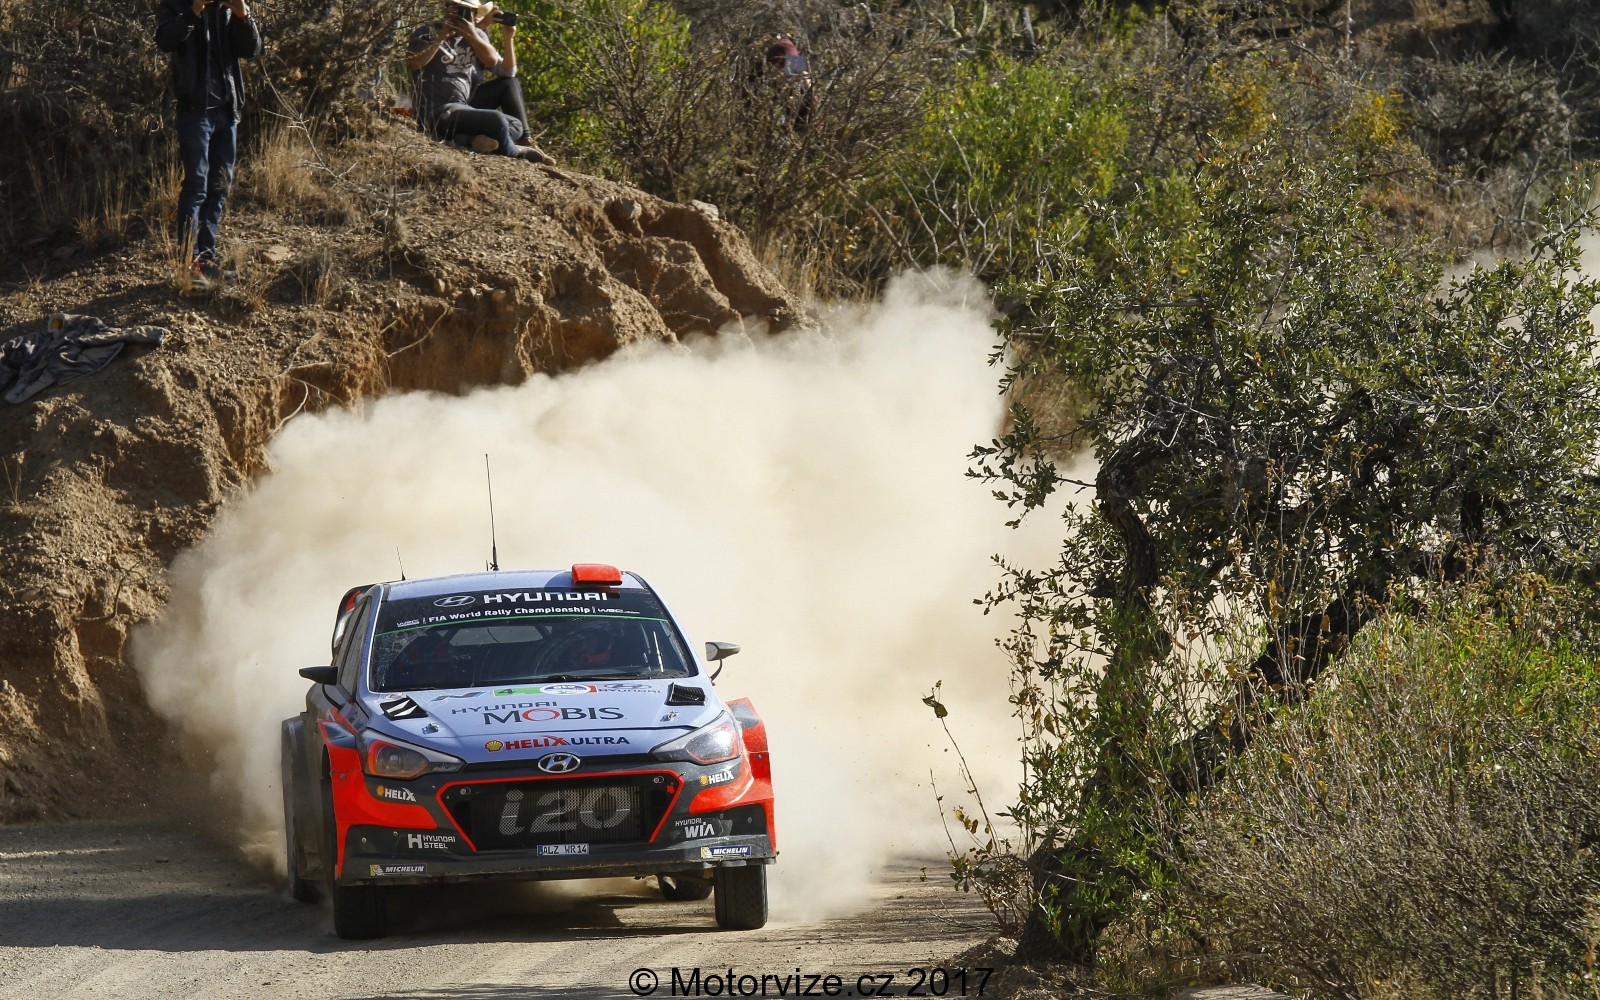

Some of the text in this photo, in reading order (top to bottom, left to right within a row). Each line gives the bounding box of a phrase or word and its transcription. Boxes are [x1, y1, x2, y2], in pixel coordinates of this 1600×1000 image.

[483, 592, 608, 604] HYUNDAI
[428, 615, 447, 623] FIA
[449, 611, 481, 620] World
[484, 608, 512, 616] Rally
[514, 606, 591, 614] Championship
[451, 701, 558, 715] HYUNDAI
[482, 707, 624, 725] MOBIS
[708, 768, 735, 784] HELIX
[384, 787, 417, 802] HELIX
[500, 786, 631, 836] i20
[675, 817, 702, 827] HYUNDAI
[684, 821, 715, 838] WIA
[423, 835, 456, 843] HYUNDAI
[543, 844, 588, 854] ALZ WR14
[713, 846, 749, 854] MICHELIN
[385, 865, 424, 873] MICHELIN
